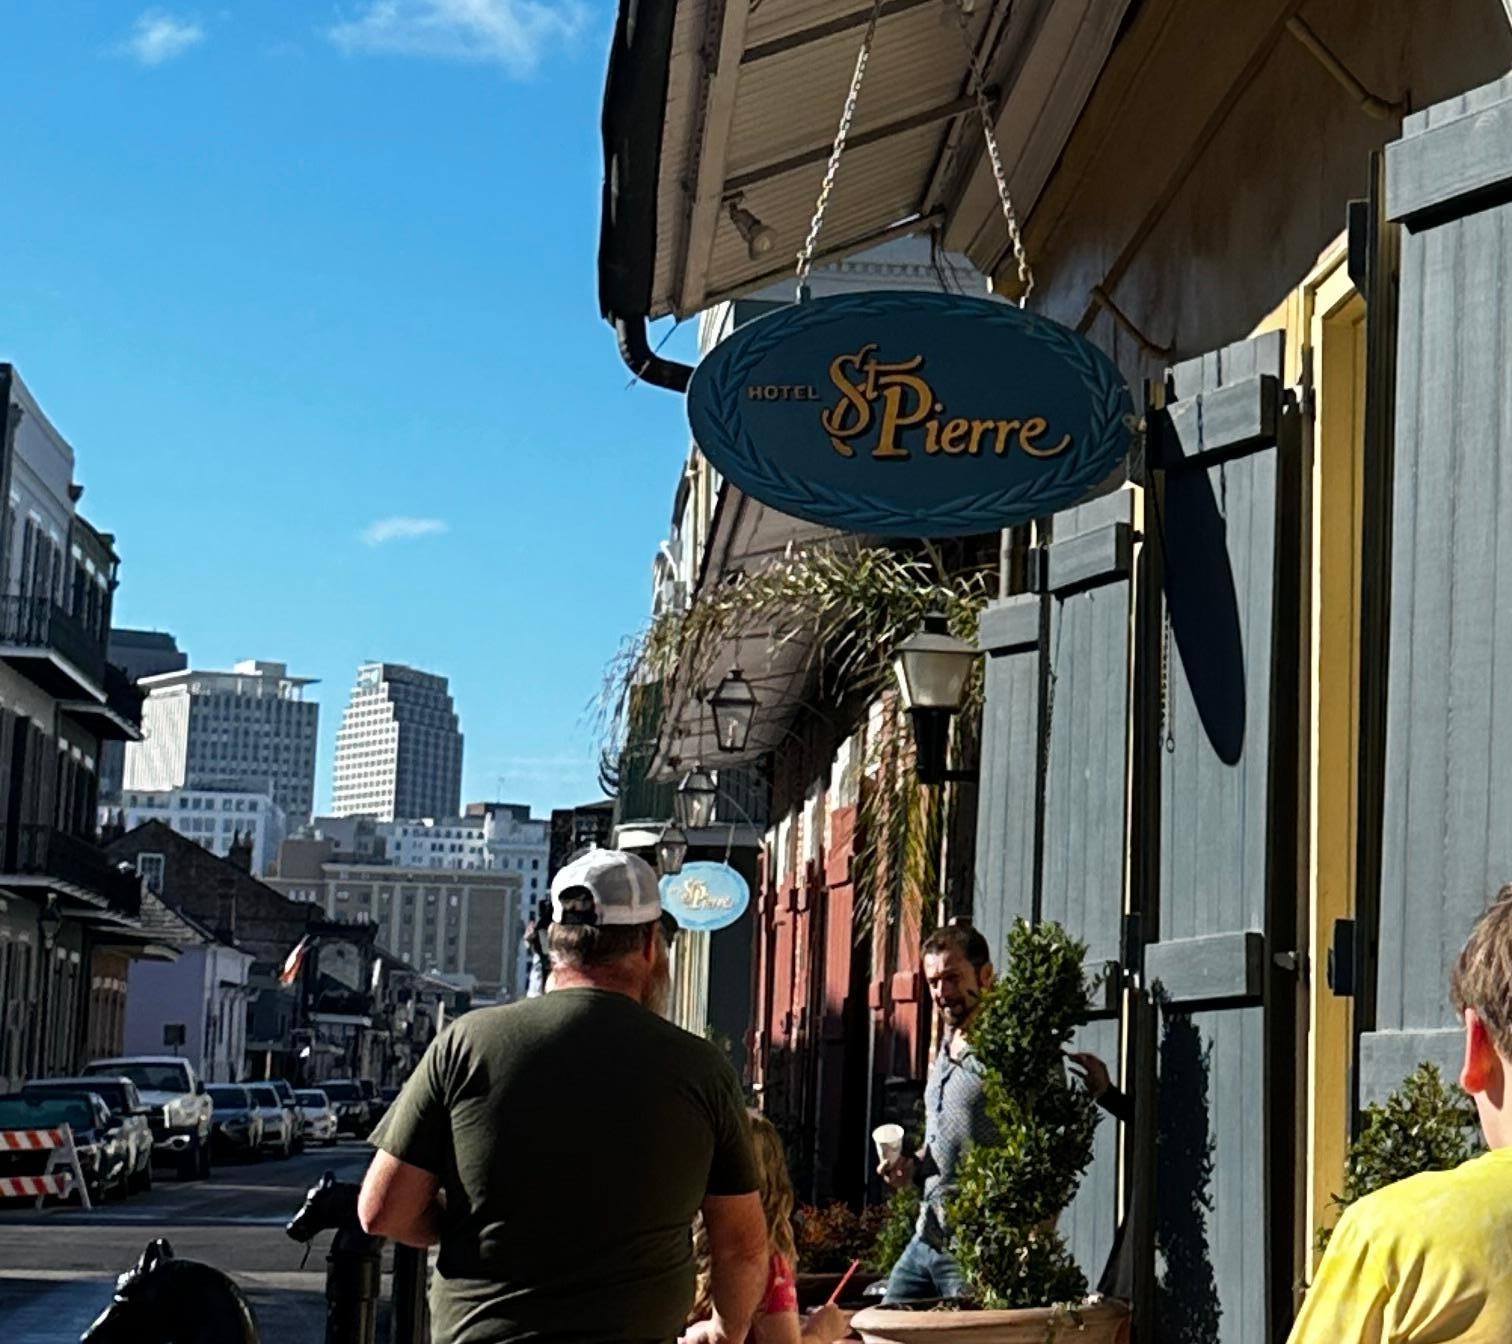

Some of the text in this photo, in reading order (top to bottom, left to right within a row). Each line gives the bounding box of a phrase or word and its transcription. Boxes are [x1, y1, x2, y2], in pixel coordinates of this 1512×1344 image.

[748, 344, 1071, 457] HOTEL St Pierre
